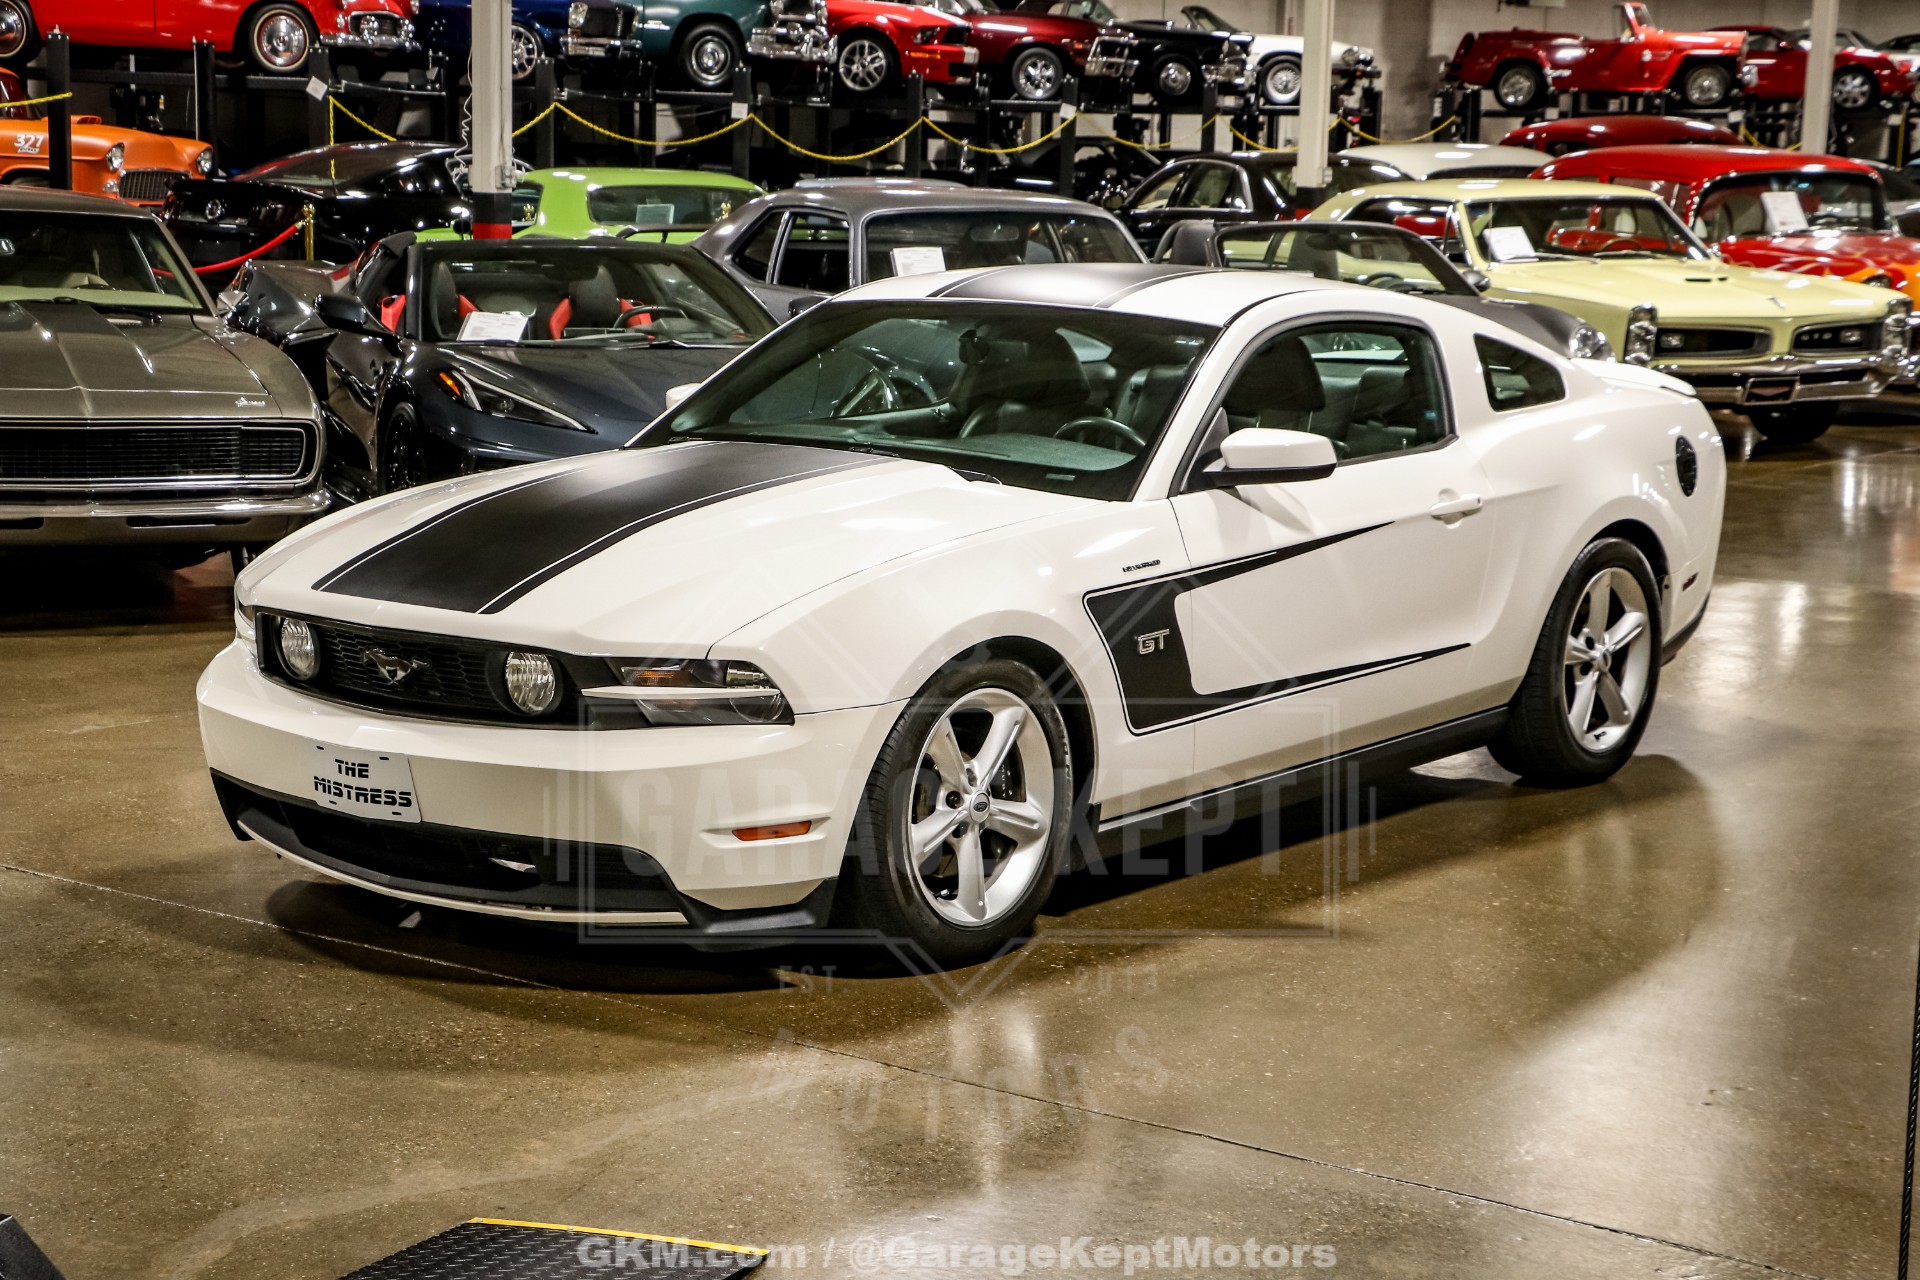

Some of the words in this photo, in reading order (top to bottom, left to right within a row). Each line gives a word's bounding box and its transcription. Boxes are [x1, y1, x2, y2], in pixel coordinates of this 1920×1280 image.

[14, 134, 44, 148] 327
[1138, 628, 1170, 655] GT
[334, 758, 369, 778] THE
[313, 775, 412, 807] MISTRESS
